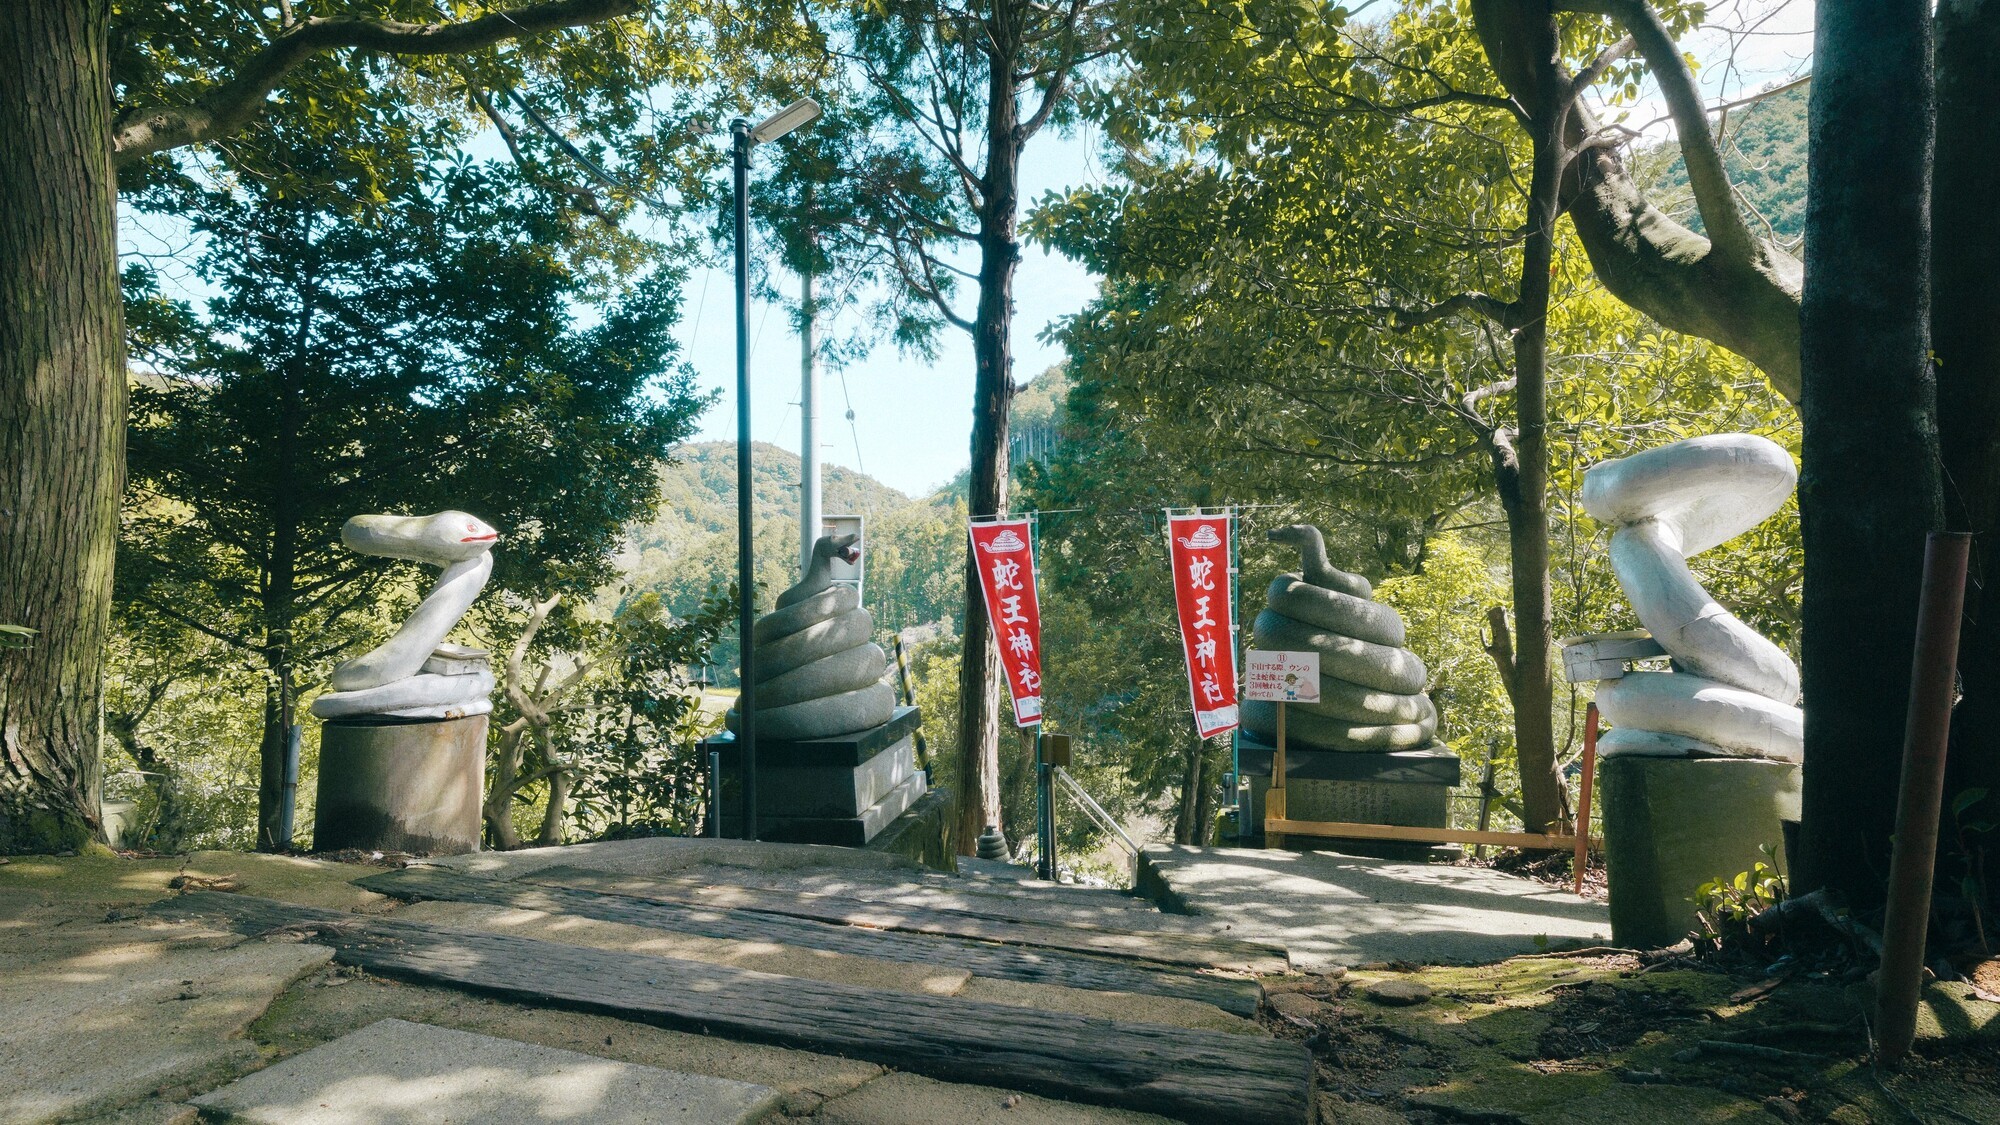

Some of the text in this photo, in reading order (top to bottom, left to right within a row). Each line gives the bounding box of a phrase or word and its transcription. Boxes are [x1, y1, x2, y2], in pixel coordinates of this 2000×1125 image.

[992, 558, 1041, 693] 蛇王神社
[1189, 556, 1224, 704] 蛇王神社
